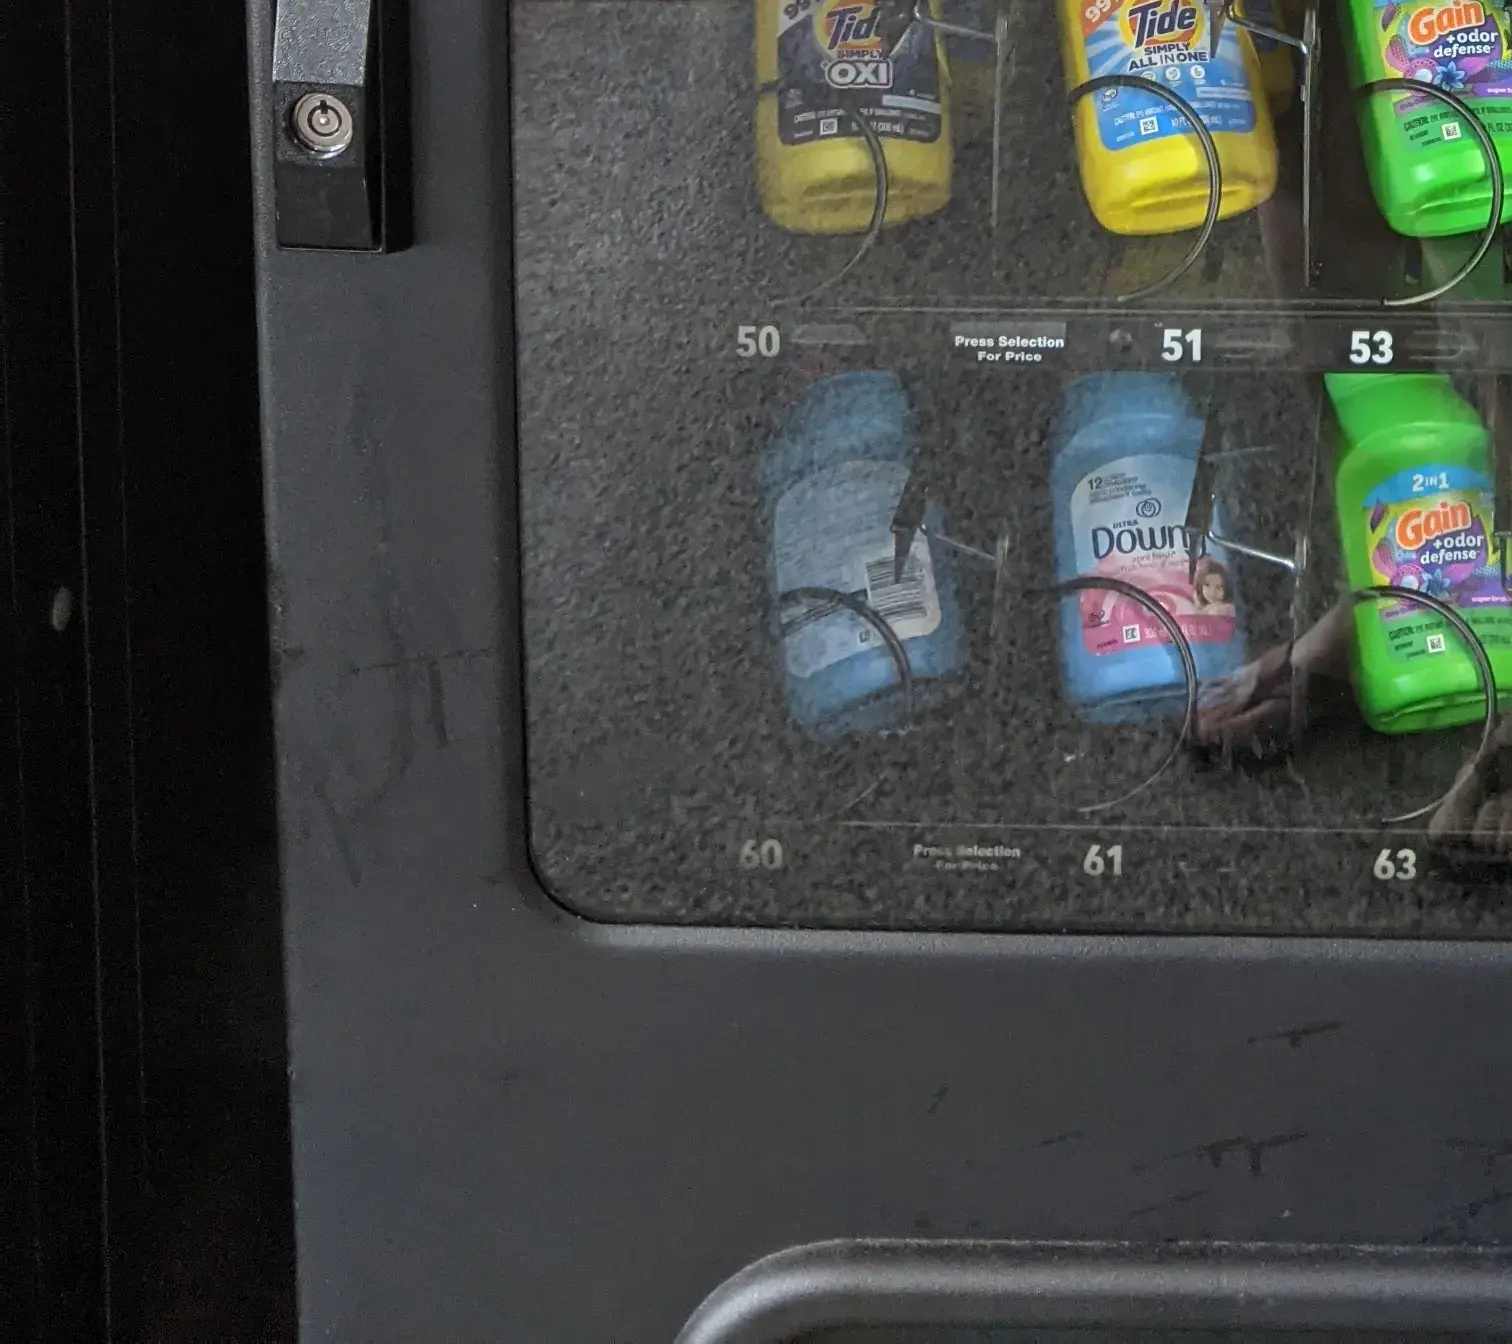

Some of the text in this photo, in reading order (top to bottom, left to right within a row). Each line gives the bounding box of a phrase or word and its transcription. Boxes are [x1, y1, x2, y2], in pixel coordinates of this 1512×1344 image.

[1127, 0, 1197, 49] Tide
[1407, 0, 1485, 45] Gain
[1446, 29, 1499, 44] +odor
[1434, 43, 1491, 58] defense
[736, 325, 780, 356] 50
[1161, 329, 1202, 360] 51
[1350, 331, 1393, 363] 53
[1396, 501, 1472, 550] Gain
[740, 839, 781, 869] 60
[1083, 845, 1122, 876] 61
[1374, 849, 1416, 880] 63
